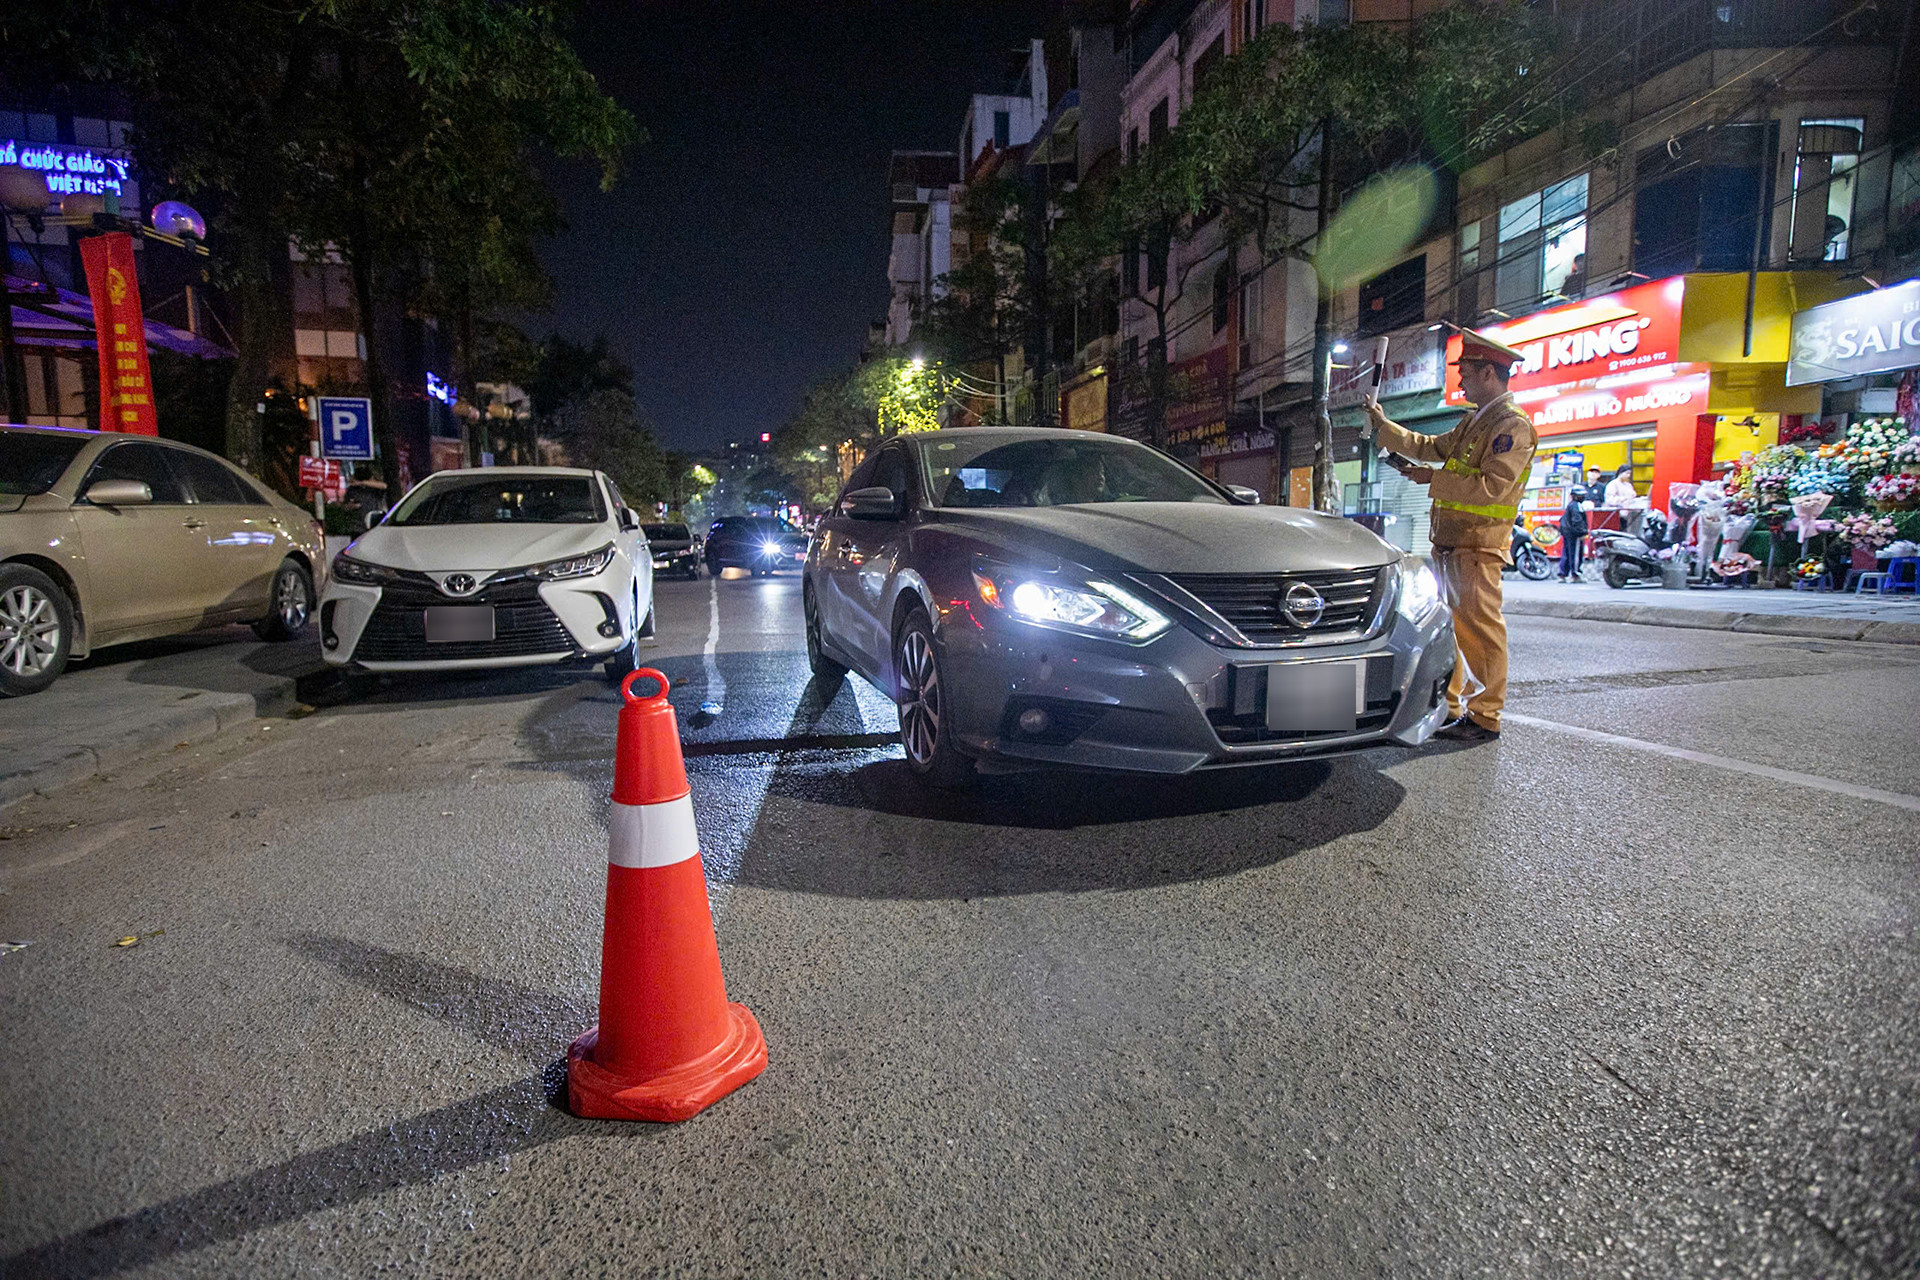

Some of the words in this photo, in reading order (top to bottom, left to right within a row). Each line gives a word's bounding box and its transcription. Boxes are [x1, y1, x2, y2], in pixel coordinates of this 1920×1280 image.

[20, 146, 65, 170] CHỨC
[1548, 318, 1639, 369] KING
[331, 410, 358, 441] P
